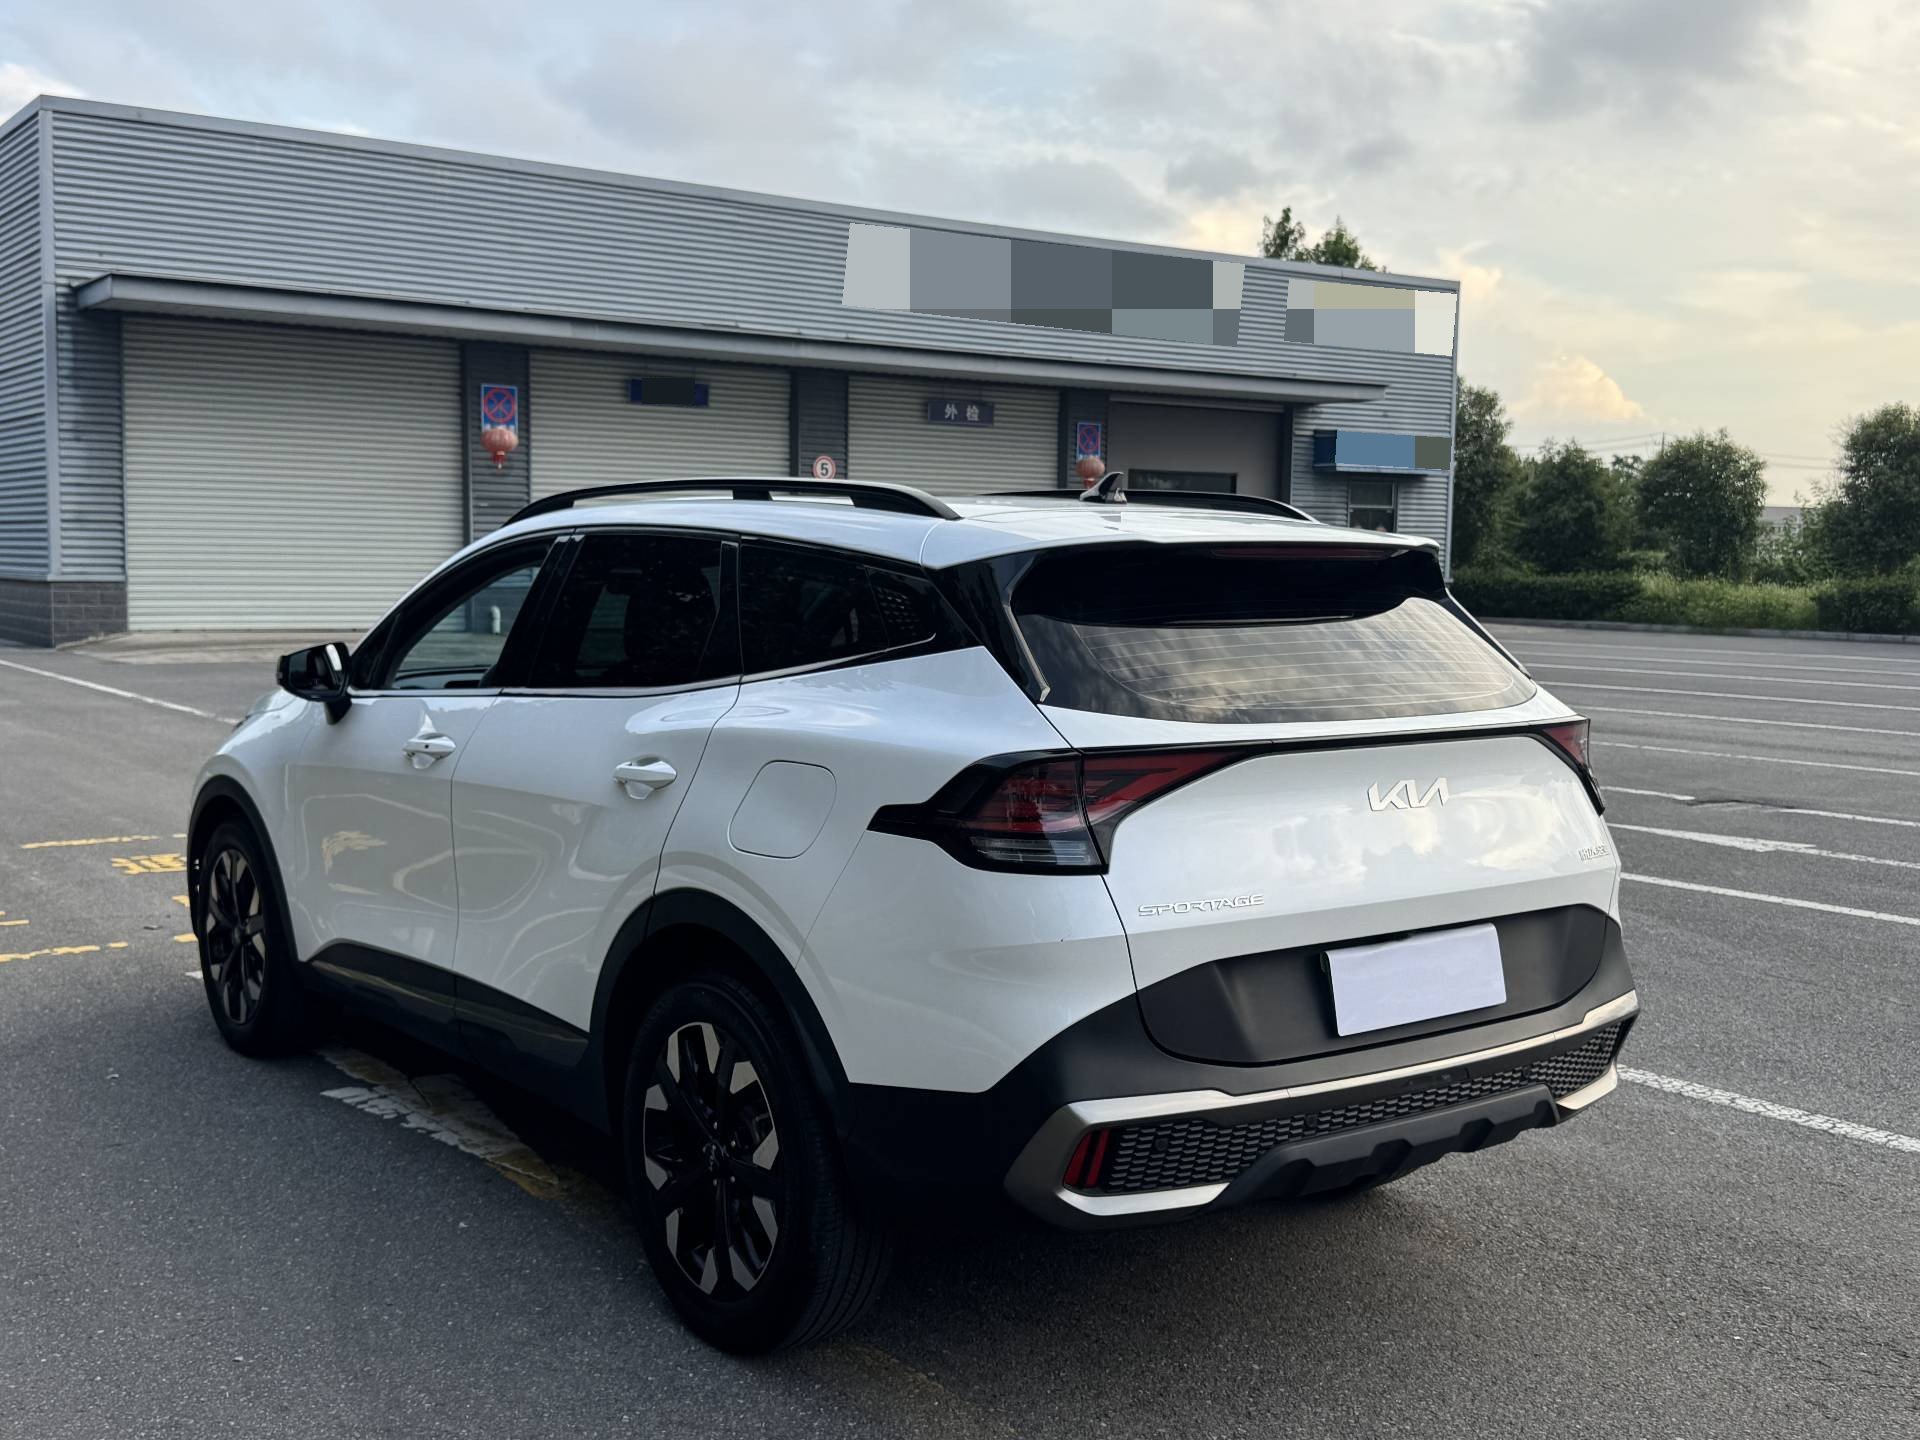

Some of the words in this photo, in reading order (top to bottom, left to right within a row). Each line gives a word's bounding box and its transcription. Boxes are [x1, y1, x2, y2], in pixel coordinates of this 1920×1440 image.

[820, 462, 829, 477] 5
[1367, 777, 1449, 811] KIA
[1138, 894, 1265, 917] SPORTAGE
